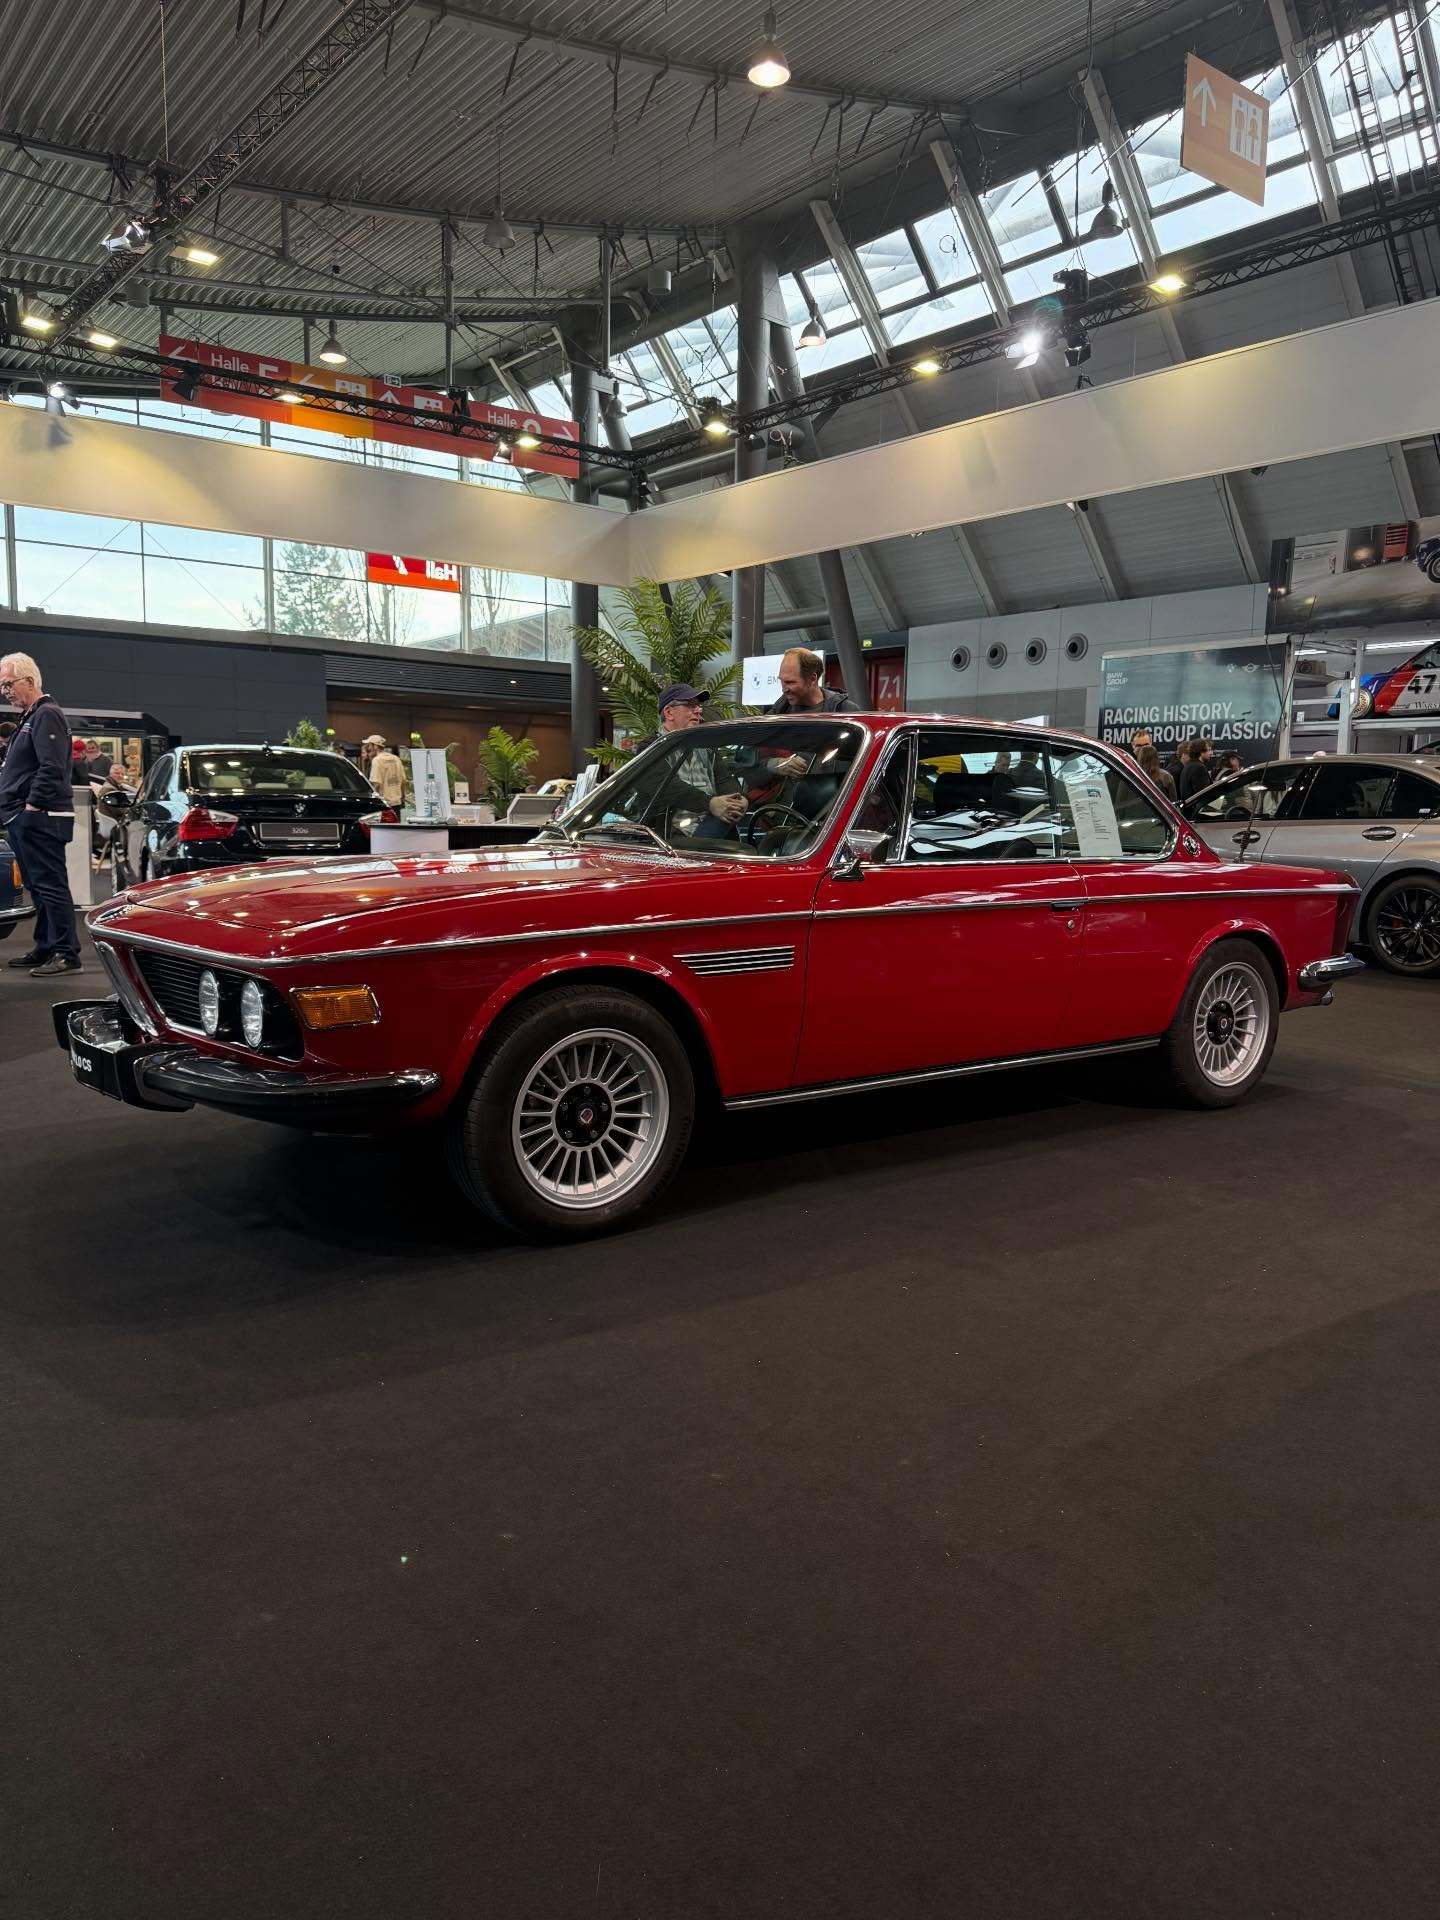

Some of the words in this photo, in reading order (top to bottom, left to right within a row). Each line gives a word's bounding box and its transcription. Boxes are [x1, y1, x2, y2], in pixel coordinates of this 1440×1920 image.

[211, 352, 249, 374] Halle
[487, 410, 517, 429] Halle
[879, 675, 900, 700] 7.1
[1104, 706, 1160, 726] RACING
[1163, 702, 1236, 722] HISTORY.
[1200, 720, 1276, 741] CLASSIC.
